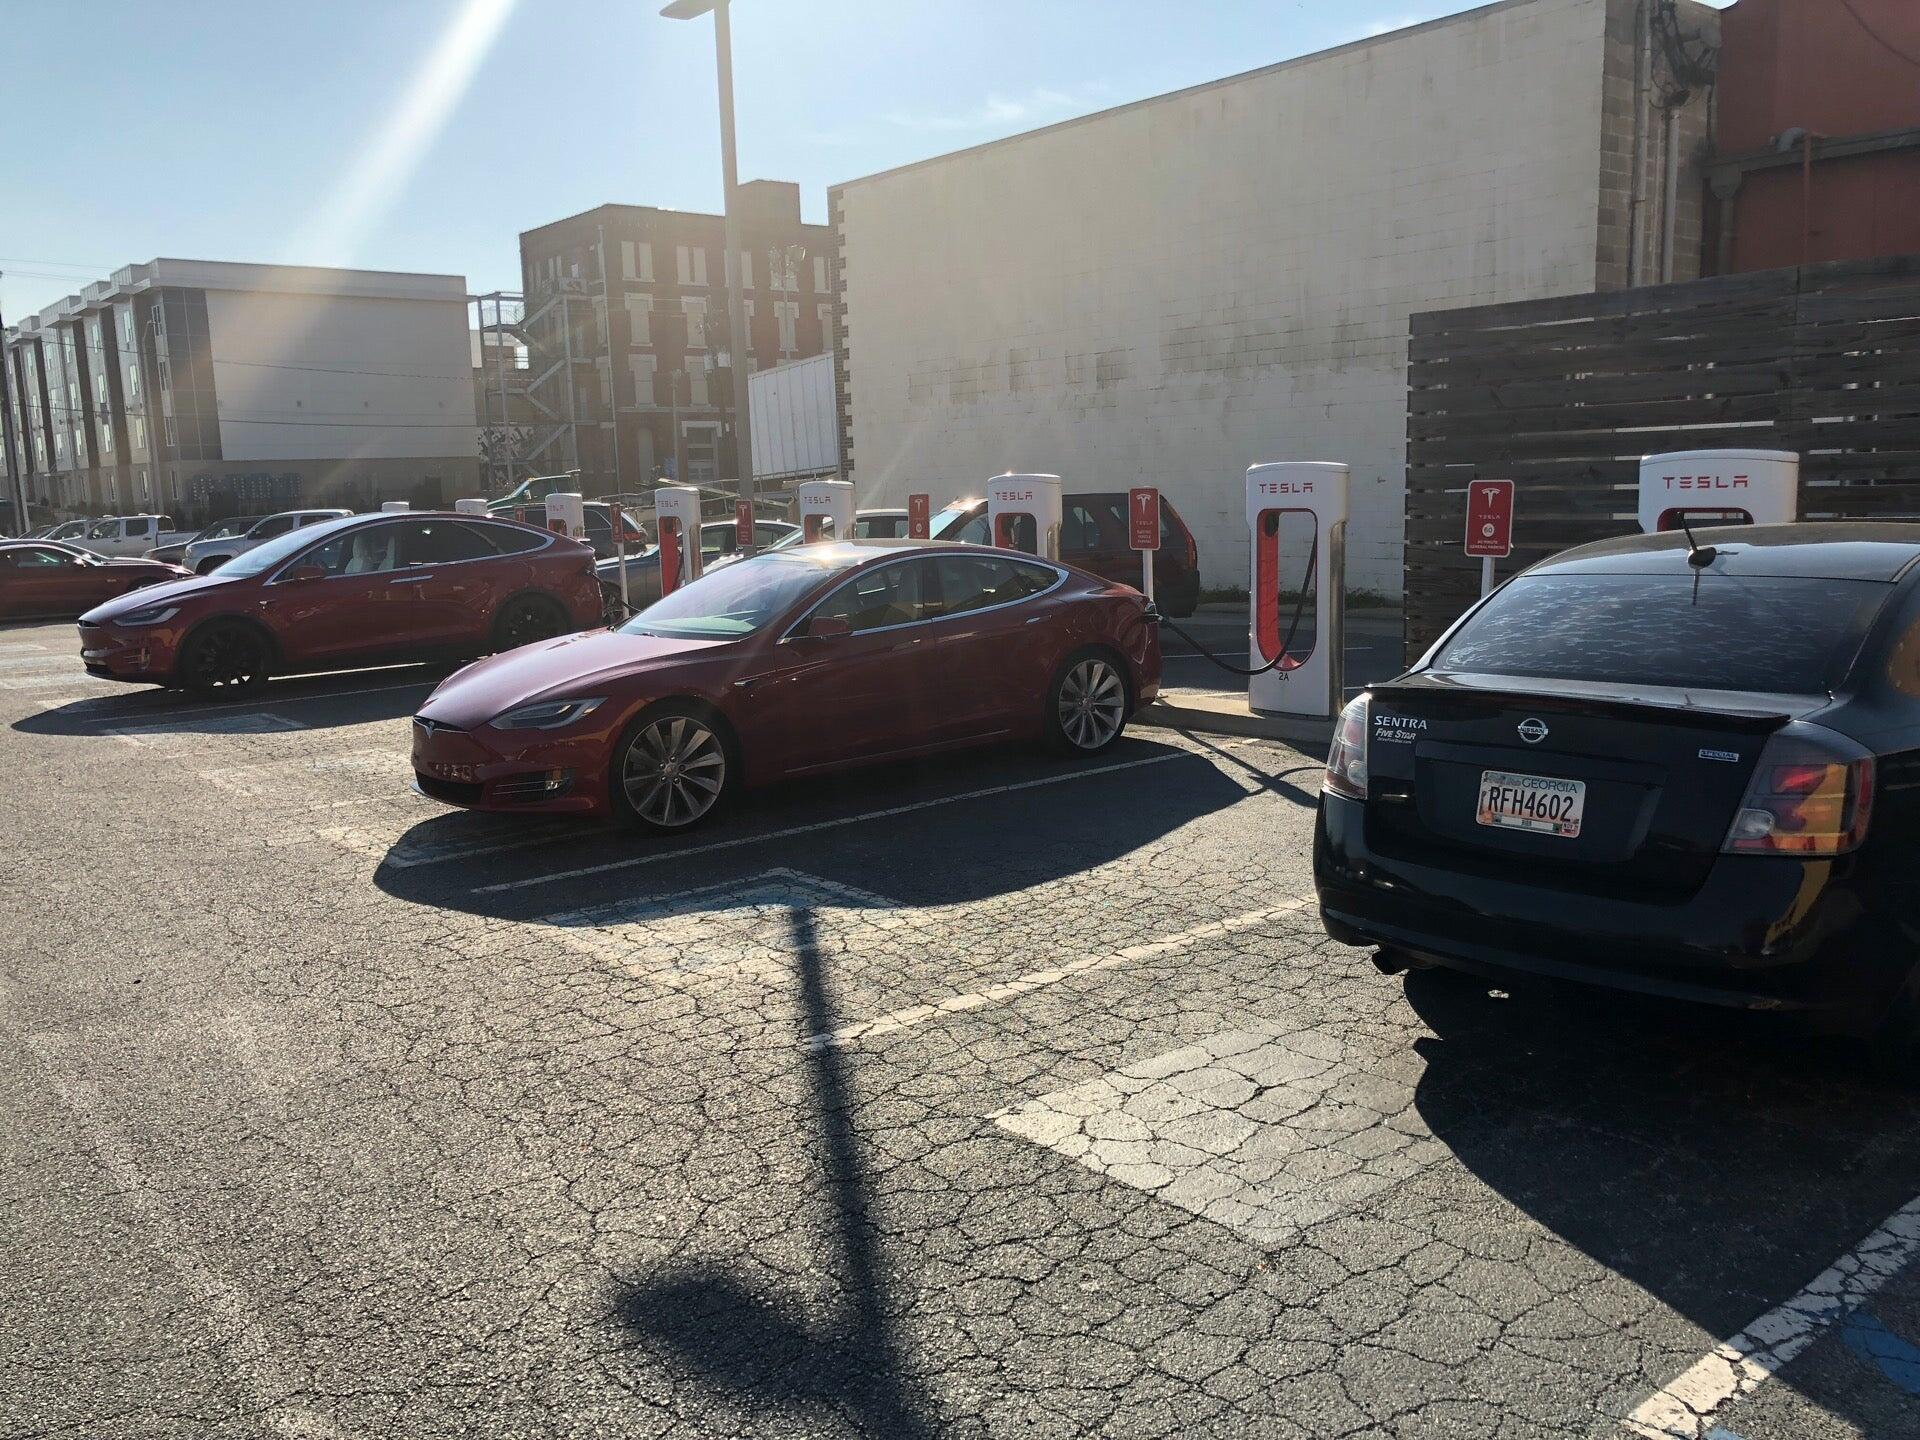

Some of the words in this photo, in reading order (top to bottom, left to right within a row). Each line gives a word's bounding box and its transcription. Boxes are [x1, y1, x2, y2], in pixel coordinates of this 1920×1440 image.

[1259, 482, 1313, 494] TESLA
[1662, 475, 1748, 489] TESLA
[804, 496, 832, 504] TESLA
[994, 491, 1033, 501] TESLA
[1279, 671, 1290, 682] 2A
[1374, 715, 1428, 730] SENTRA
[1521, 777, 1578, 794] GEORGIA
[1487, 786, 1574, 822] RFH4602
